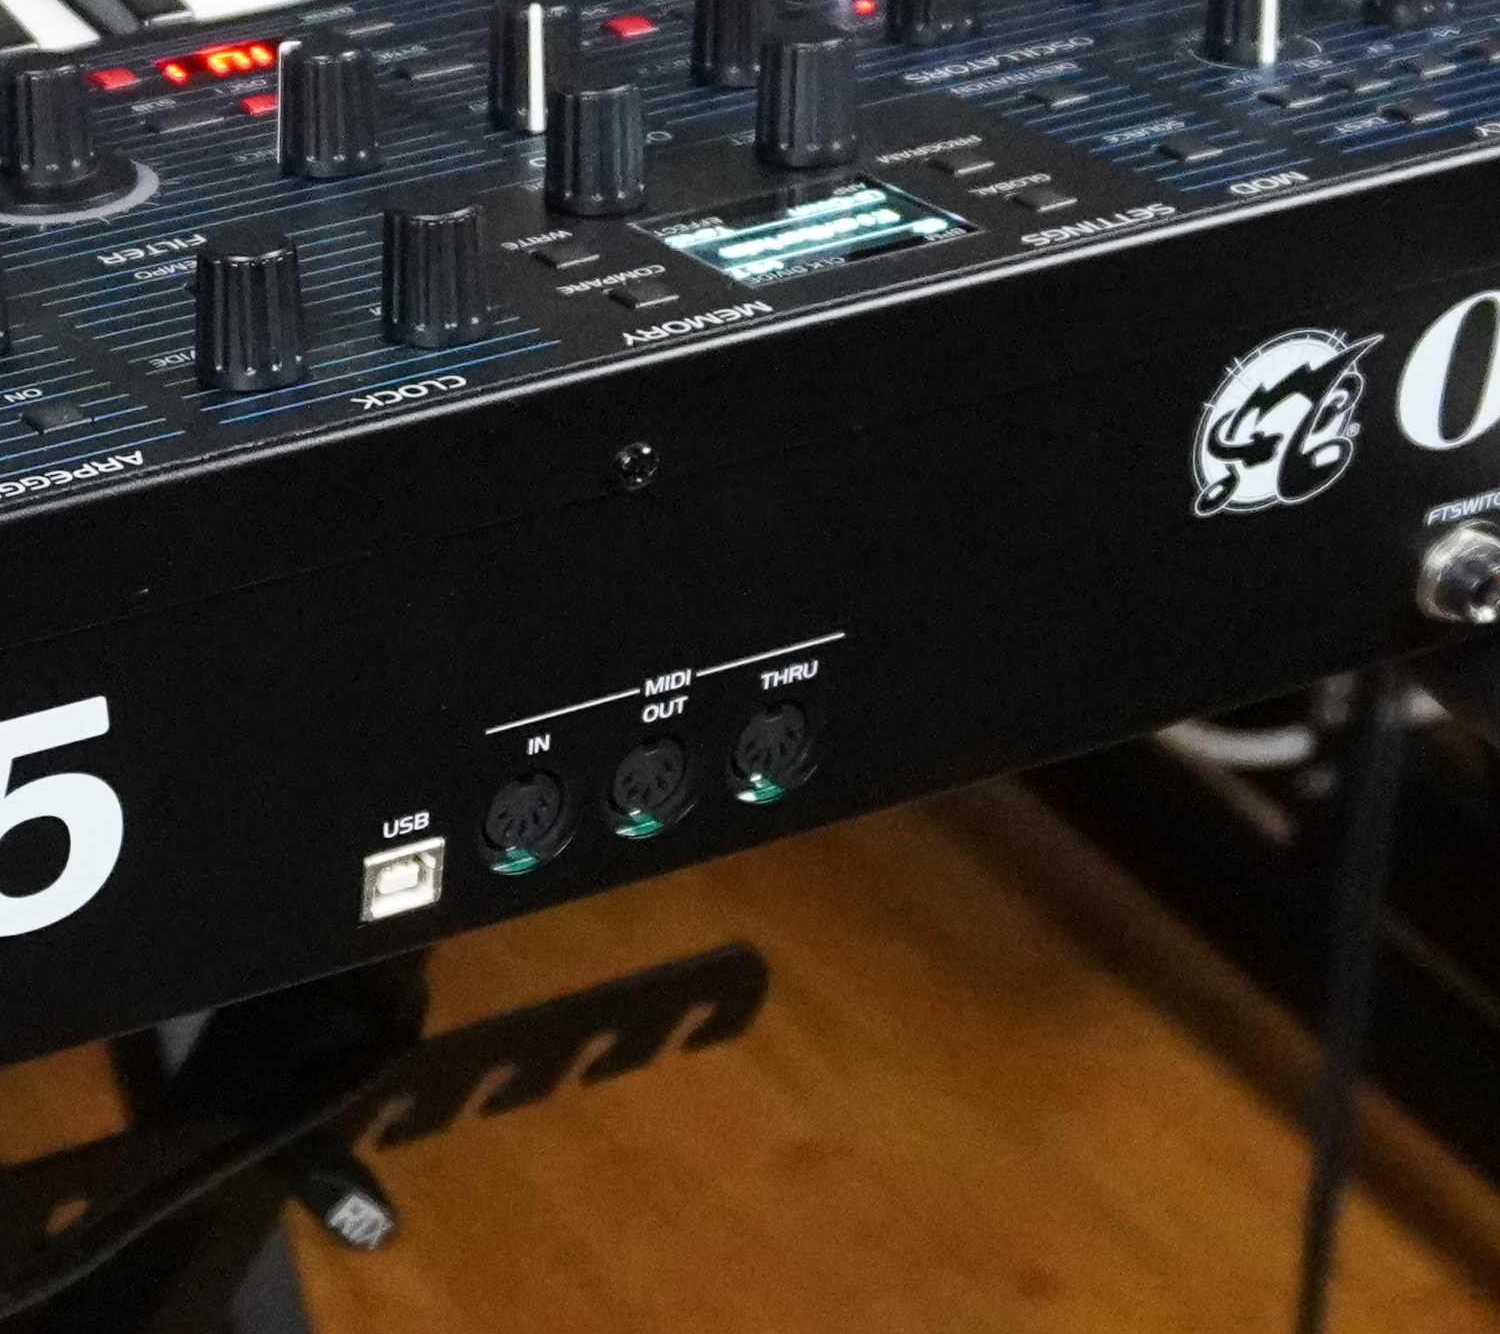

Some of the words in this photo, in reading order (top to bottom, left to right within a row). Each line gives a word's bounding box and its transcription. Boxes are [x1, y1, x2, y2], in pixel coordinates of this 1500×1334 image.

[904, 36, 1094, 83] OSCILLATORS
[1101, 118, 1185, 146] SOURCE
[875, 134, 983, 164] PROGRAM
[967, 172, 1051, 197] GLOBAL
[1229, 170, 1309, 196] MOD
[653, 216, 723, 238] EFFECT
[1020, 203, 1176, 245] SETTINGS
[97, 233, 207, 265] FILTER
[500, 229, 574, 251] WRITE
[133, 257, 197, 281] EMPO
[810, 255, 846, 269] CLK
[555, 264, 667, 297] COMPARE
[621, 297, 774, 347] MEMORY
[3, 387, 44, 404] ON
[350, 373, 468, 409] CLOCK
[643, 668, 693, 698] MIDI
[760, 660, 819, 692] THRU
[641, 696, 689, 724] OUT
[527, 733, 552, 756] IN
[382, 811, 430, 840] USB
